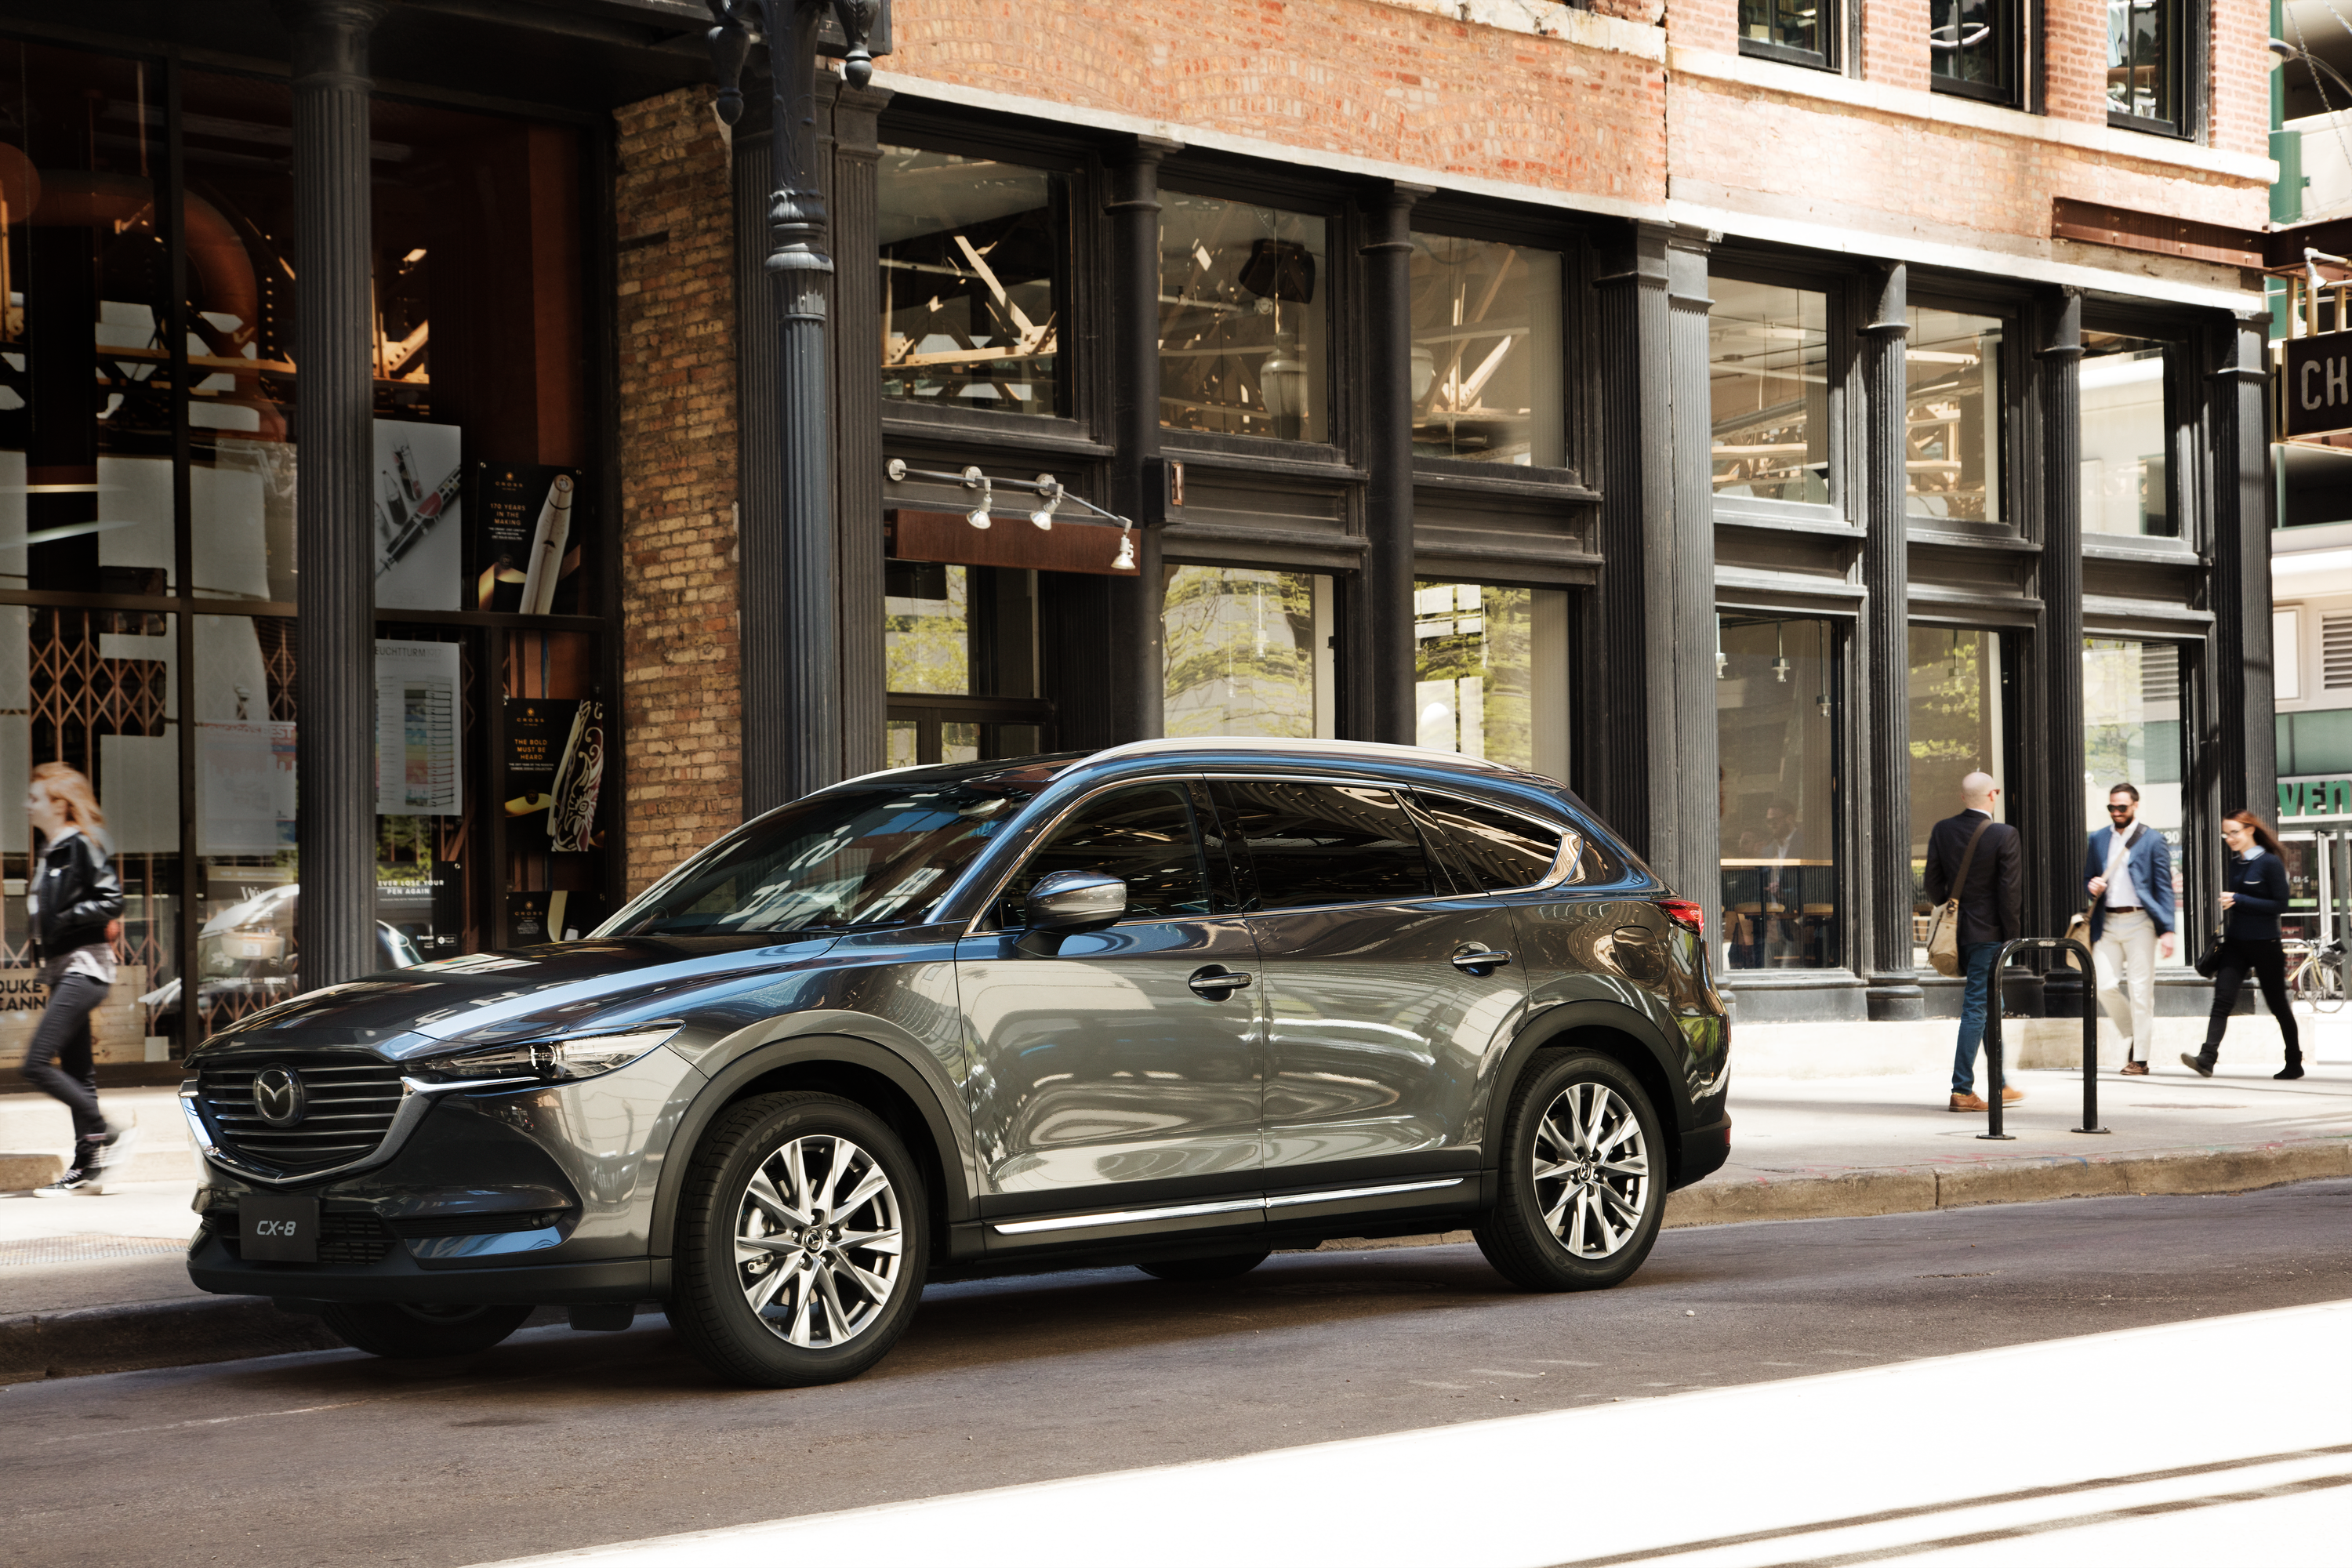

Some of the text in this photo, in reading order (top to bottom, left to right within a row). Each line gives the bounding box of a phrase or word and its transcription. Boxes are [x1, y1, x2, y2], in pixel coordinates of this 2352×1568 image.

[2301, 356, 2349, 410] CH
[748, 1114, 801, 1154] TOYO
[256, 1220, 296, 1236] CX-8
